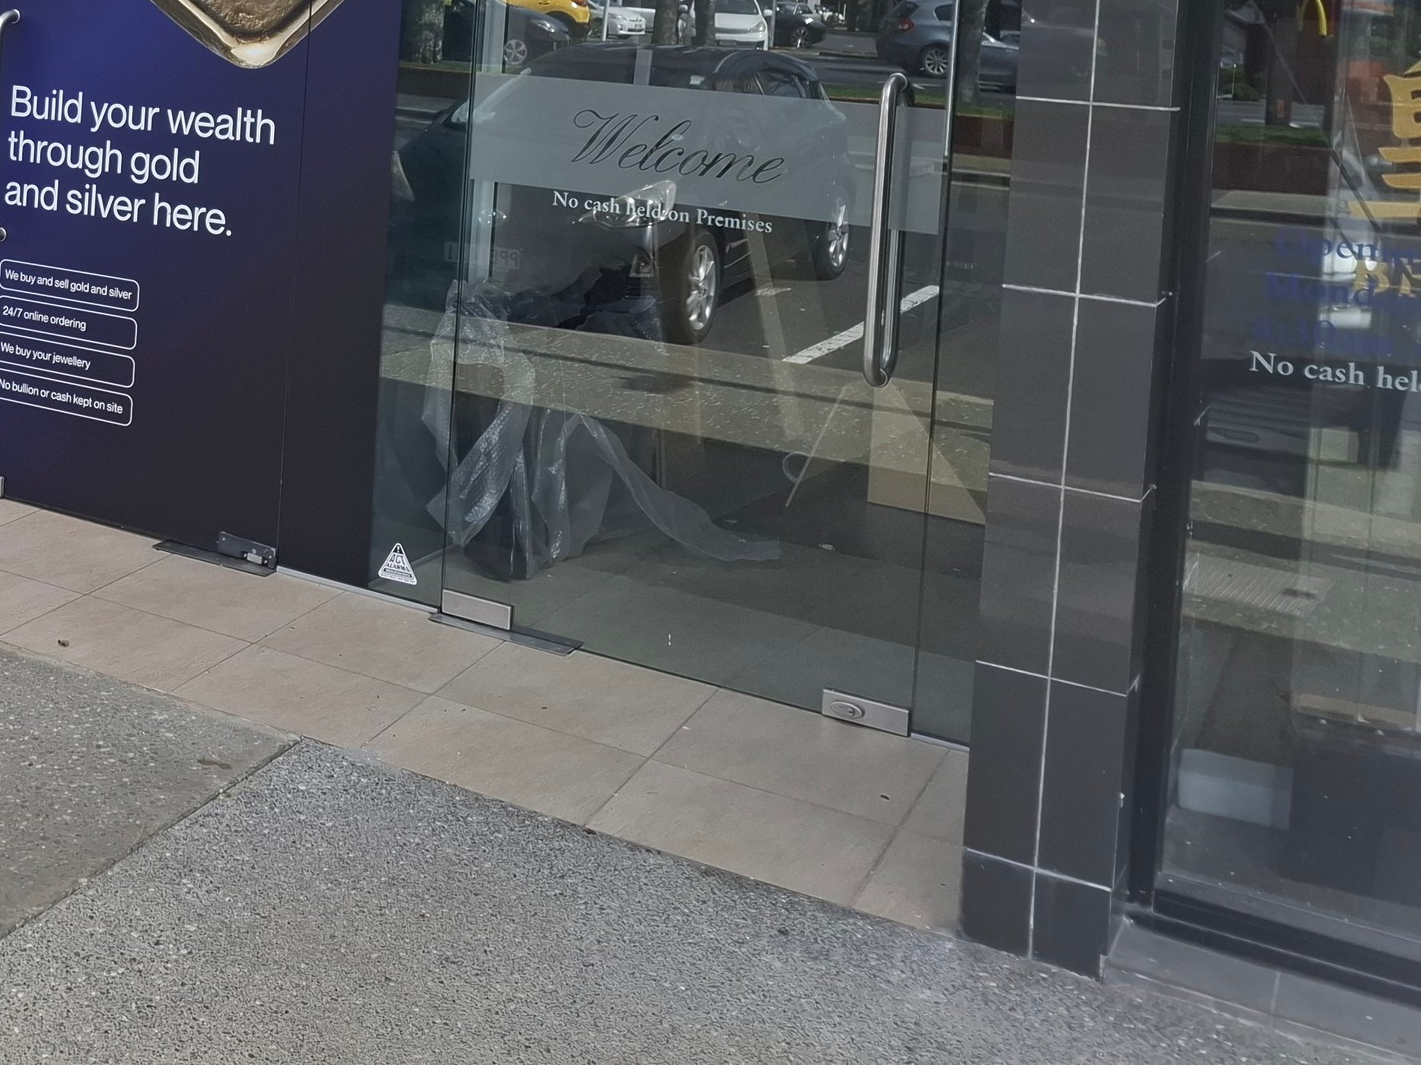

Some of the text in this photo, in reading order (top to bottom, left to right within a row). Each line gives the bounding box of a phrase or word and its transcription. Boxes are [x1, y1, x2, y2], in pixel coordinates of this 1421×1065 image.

[11, 85, 275, 144] Build your wealth
[8, 130, 199, 184] through gold
[570, 108, 787, 184] Welcome
[5, 180, 231, 236] and silver here.
[552, 191, 774, 233] No cash held on Premises
[5, 269, 132, 299] We buy and sell gold and silver
[3, 306, 86, 331] 24/7 online ordering
[1, 342, 90, 370] We buy your jewellery
[1249, 350, 1294, 375] No
[1304, 362, 1365, 386] cash
[12, 381, 39, 396] bullion
[51, 392, 71, 402] cash
[73, 394, 92, 407] kept
[94, 401, 105, 410] on
[107, 402, 123, 413] site
